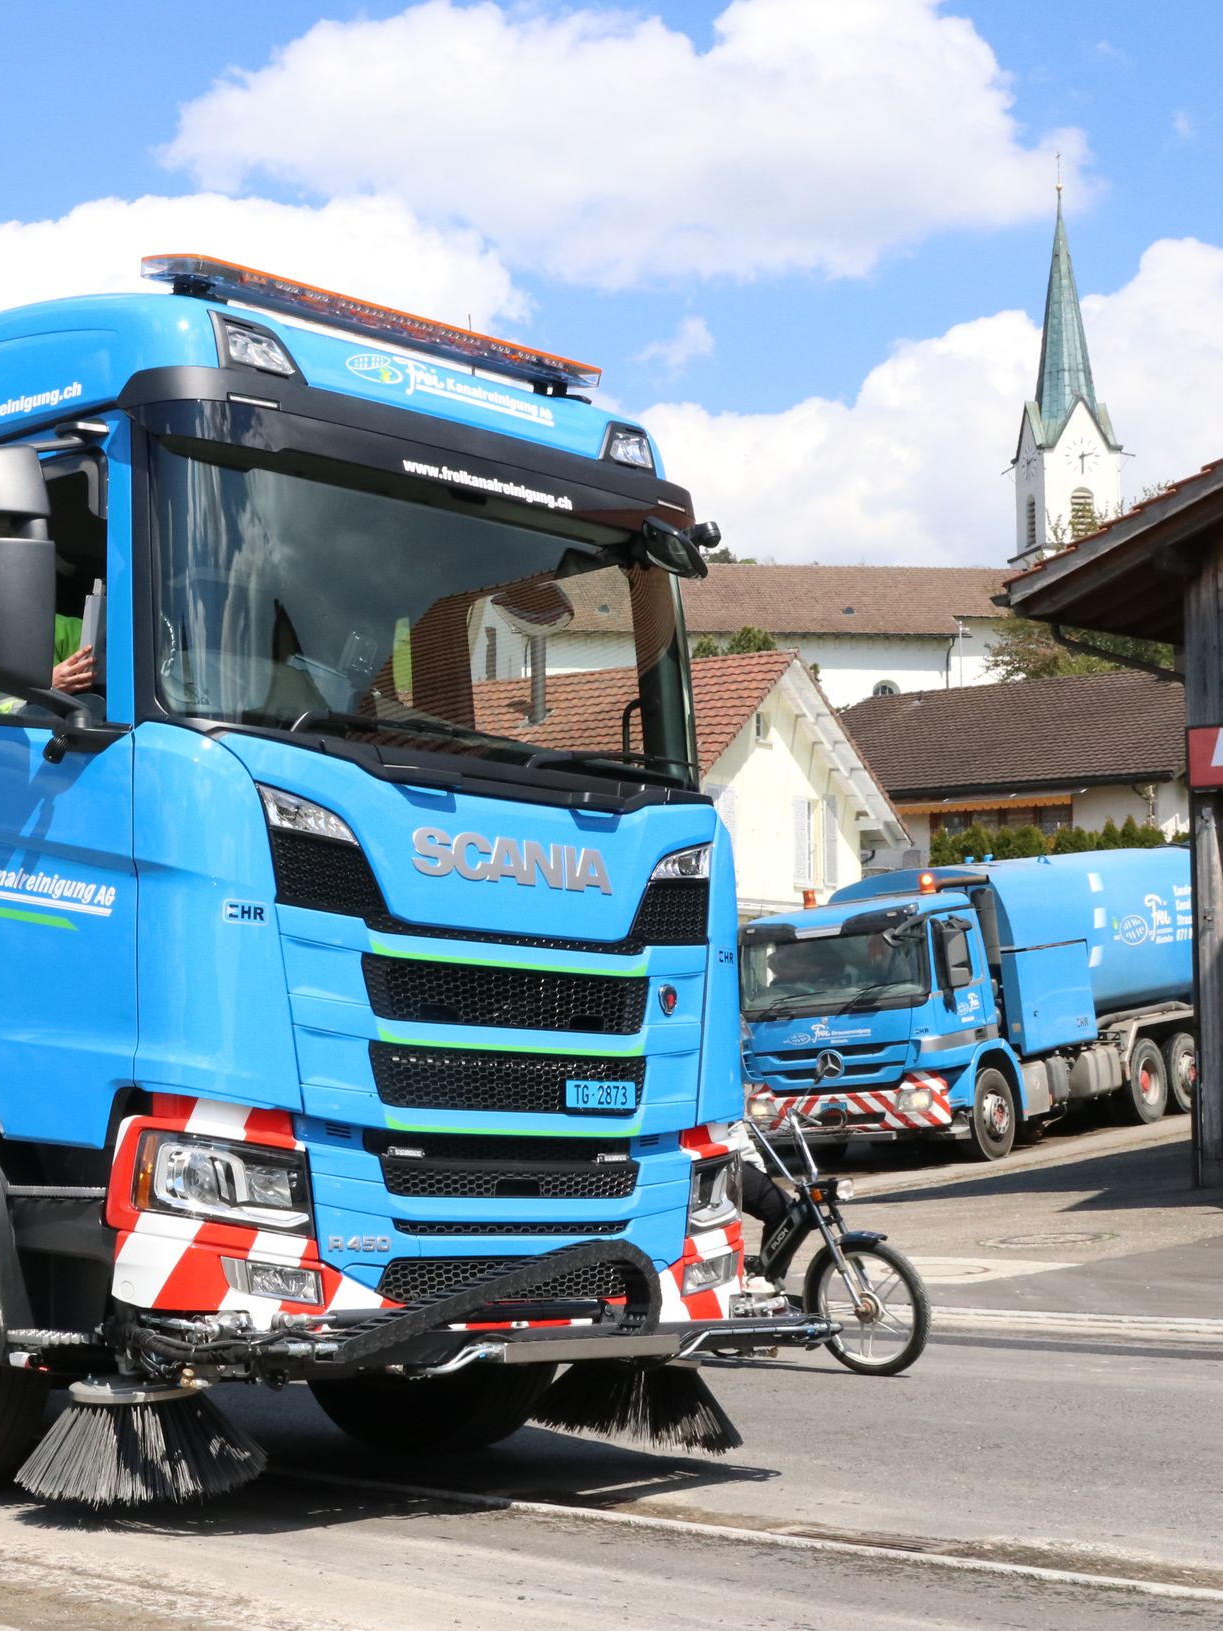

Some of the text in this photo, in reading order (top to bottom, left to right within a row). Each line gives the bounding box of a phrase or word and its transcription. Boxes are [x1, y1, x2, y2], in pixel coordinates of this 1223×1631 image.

[392, 356, 445, 395] Frei
[446, 377, 538, 417] Kanalreinigung
[403, 459, 573, 511] www.freikanalreinigung.ch
[411, 826, 613, 896] SCANIA
[94, 885, 116, 906] AG
[328, 1236, 391, 1252] R 450
[770, 1227, 789, 1250] PUCH
